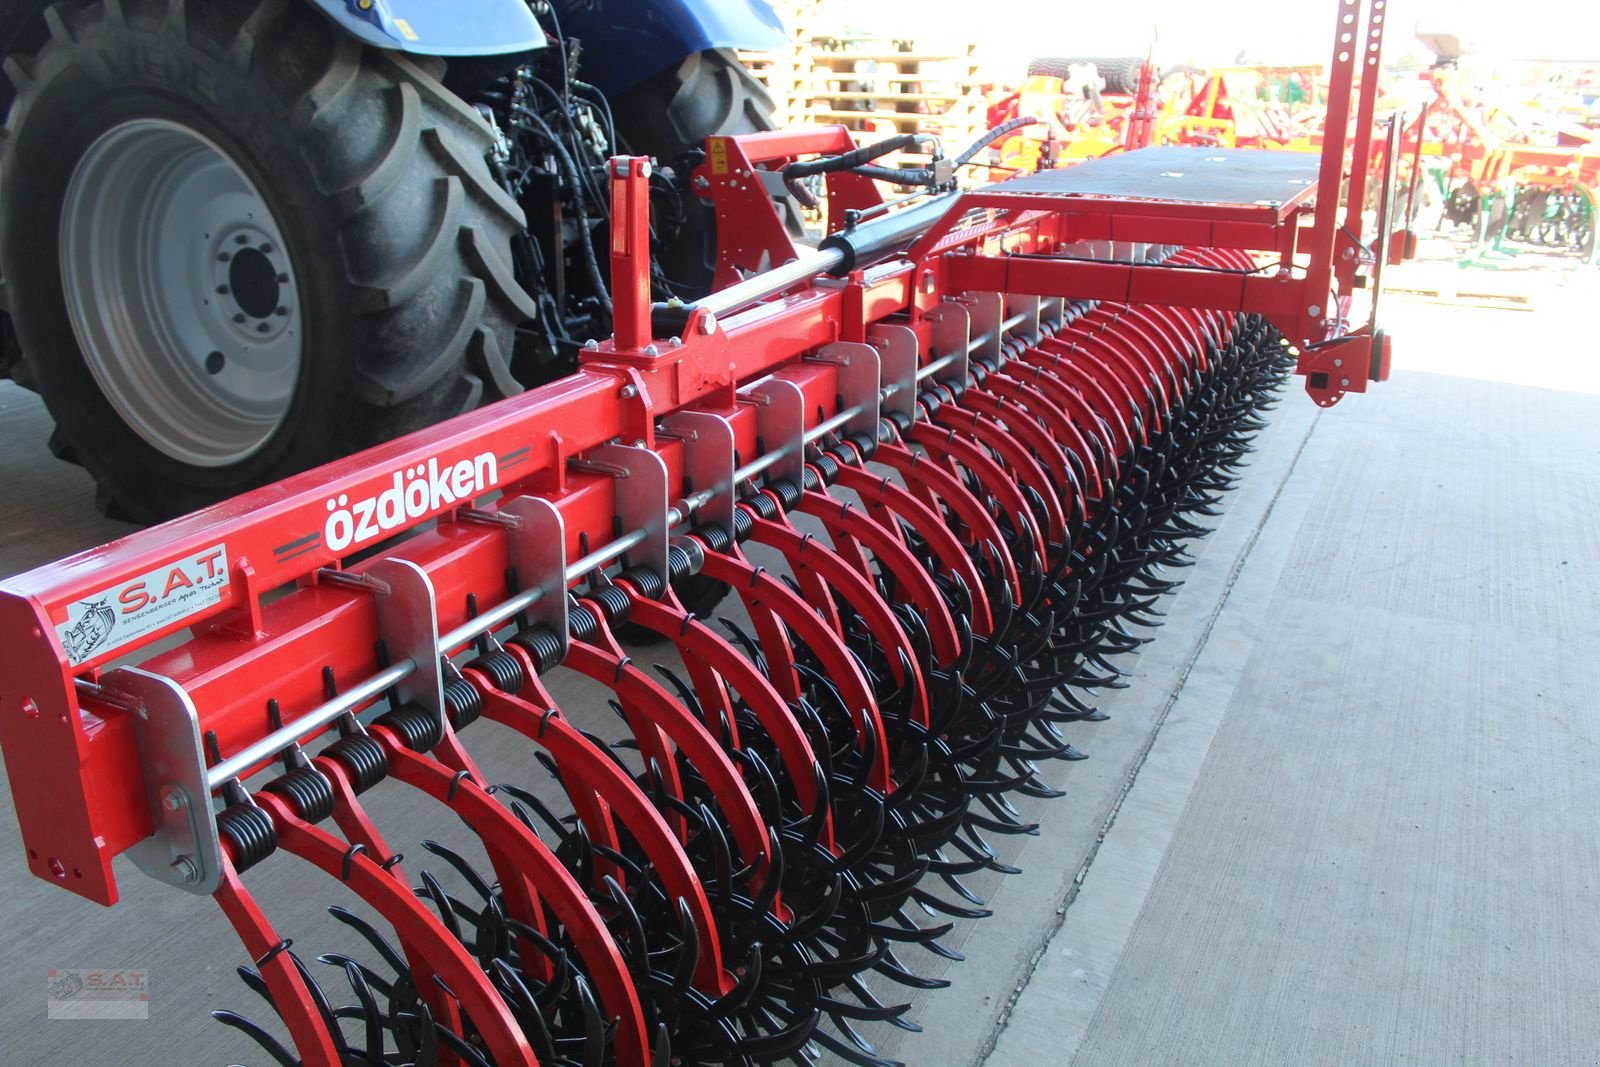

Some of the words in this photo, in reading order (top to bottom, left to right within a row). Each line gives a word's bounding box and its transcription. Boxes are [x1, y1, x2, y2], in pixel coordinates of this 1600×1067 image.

[325, 452, 498, 551] özdöken
[118, 550, 224, 614] S.A.T.
[122, 598, 176, 626] SENSENBERGER
